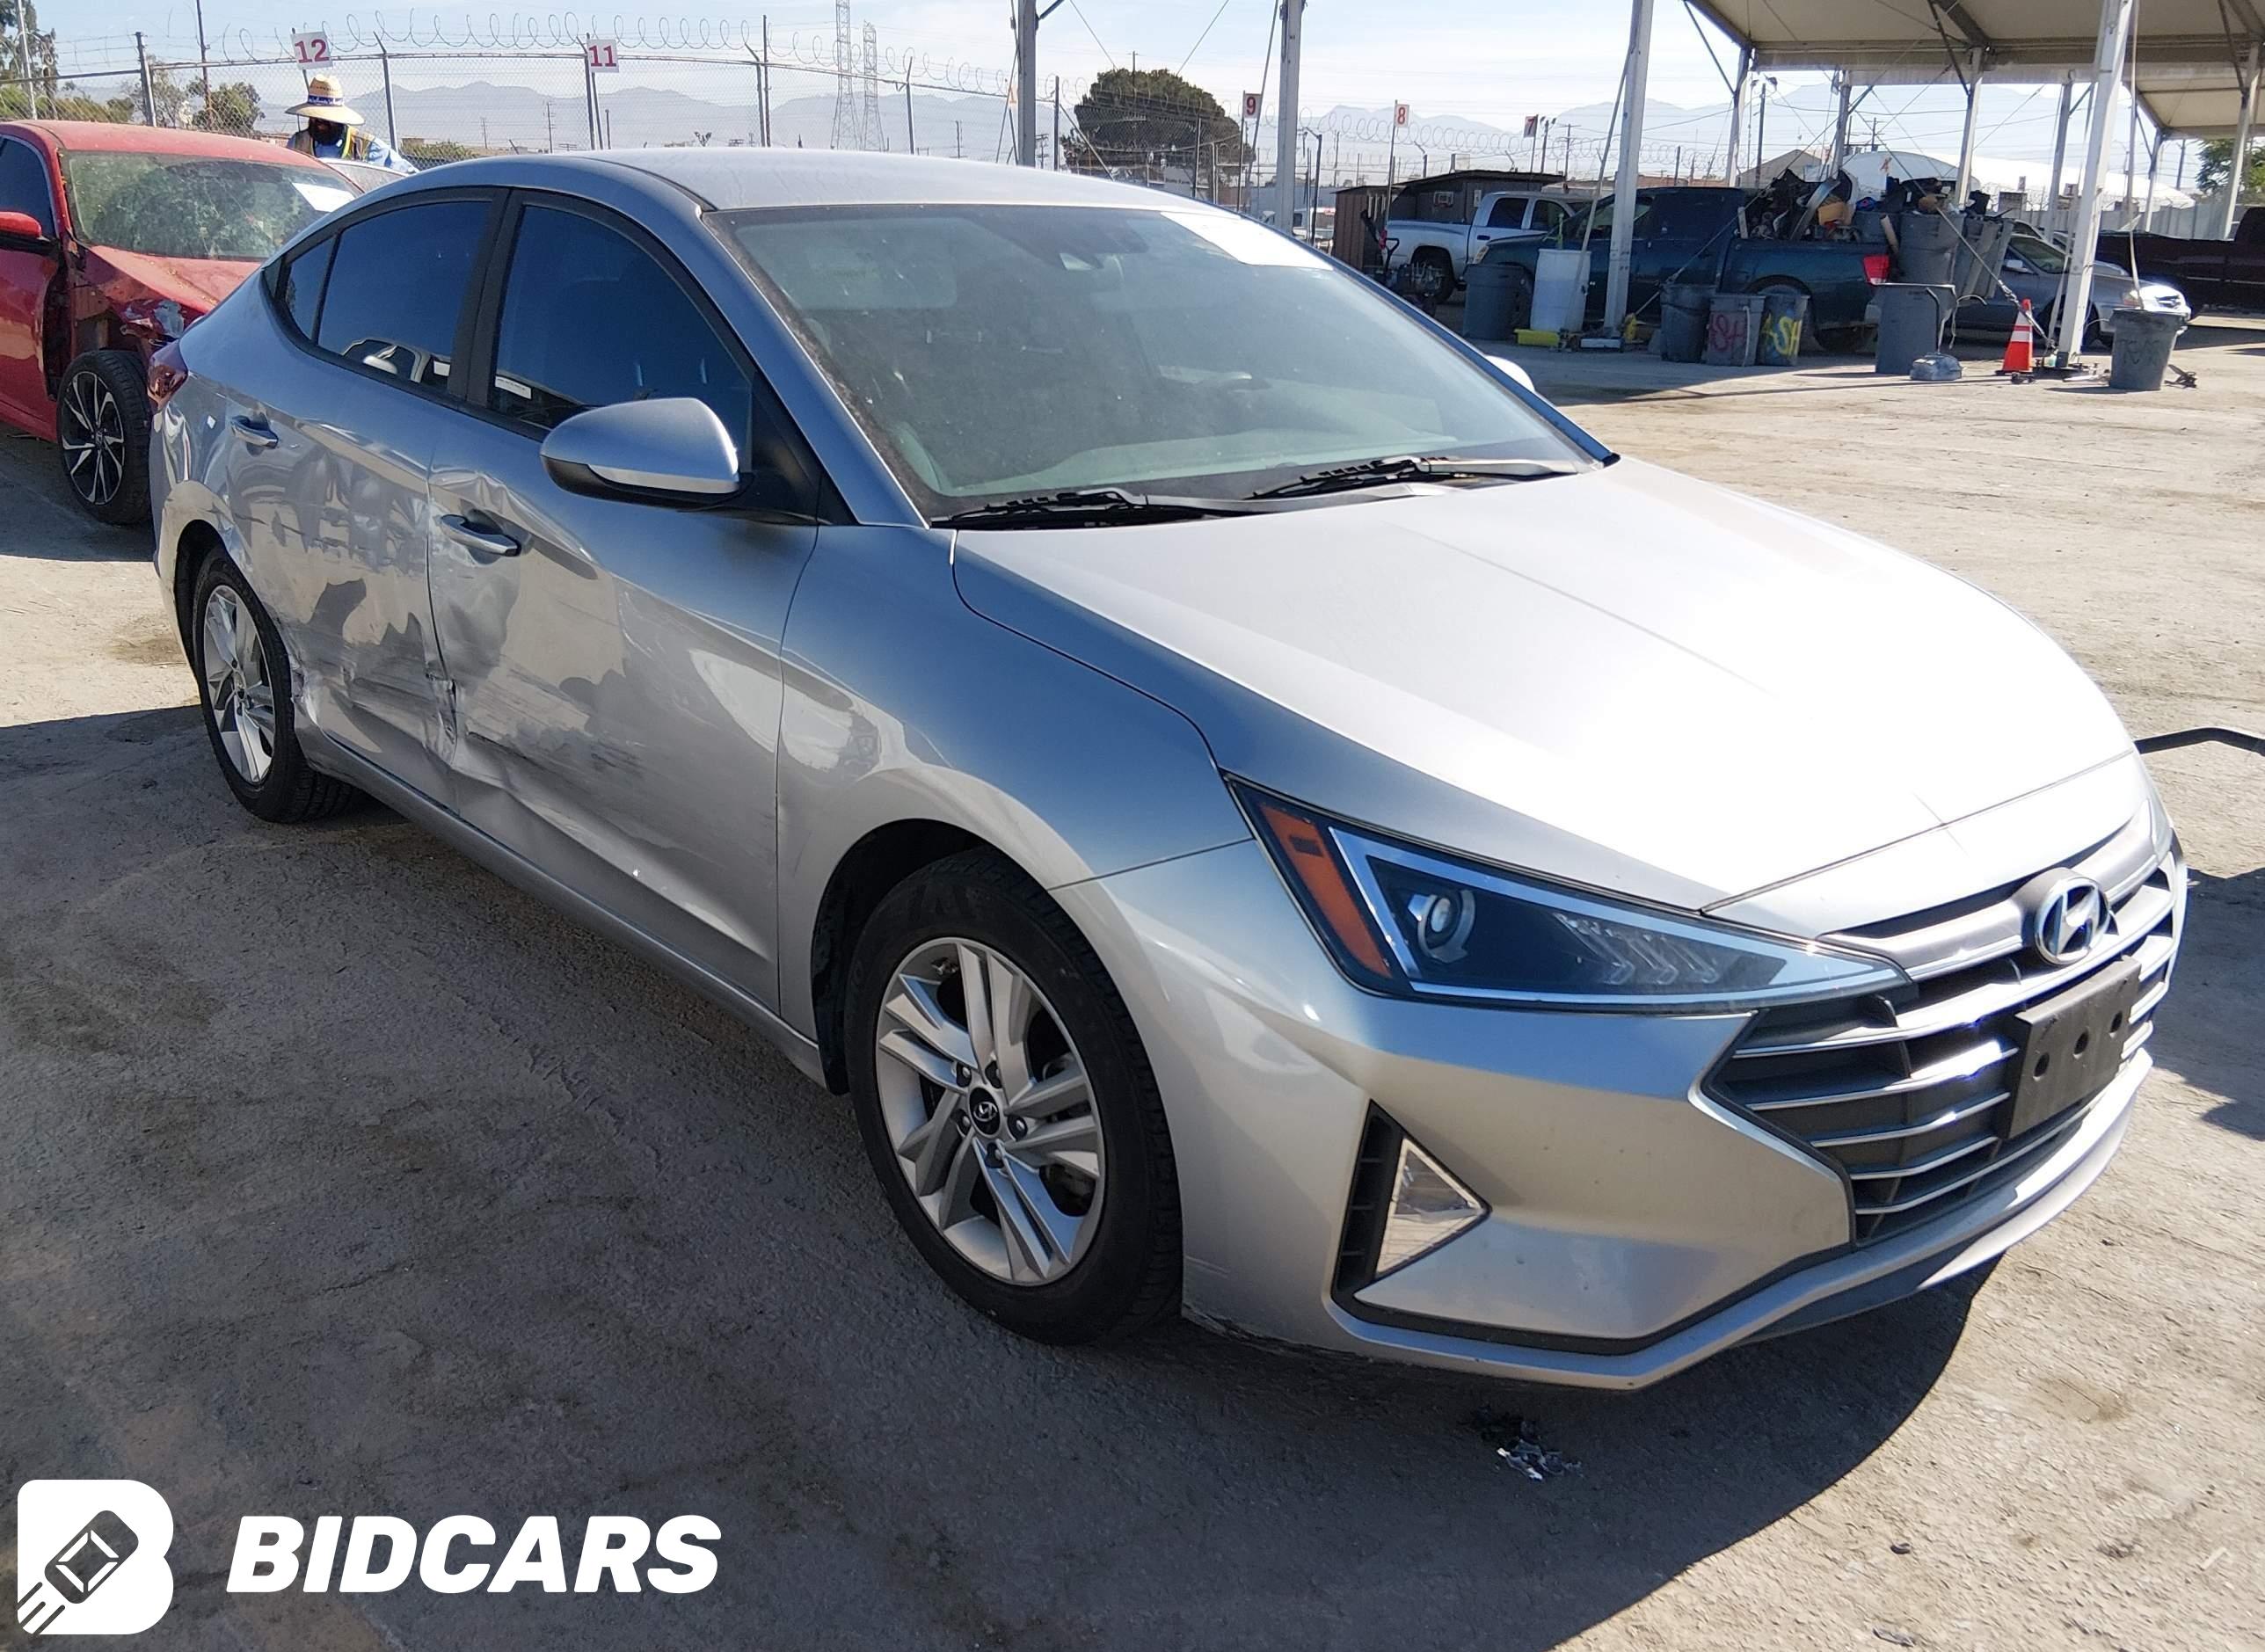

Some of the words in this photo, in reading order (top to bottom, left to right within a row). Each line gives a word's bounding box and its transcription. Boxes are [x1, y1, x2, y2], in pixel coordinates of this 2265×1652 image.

[295, 39, 330, 64] 12
[589, 45, 617, 68] 11
[1246, 96, 1256, 116] 9
[1397, 106, 1406, 125] 8
[1527, 118, 1535, 135] 7
